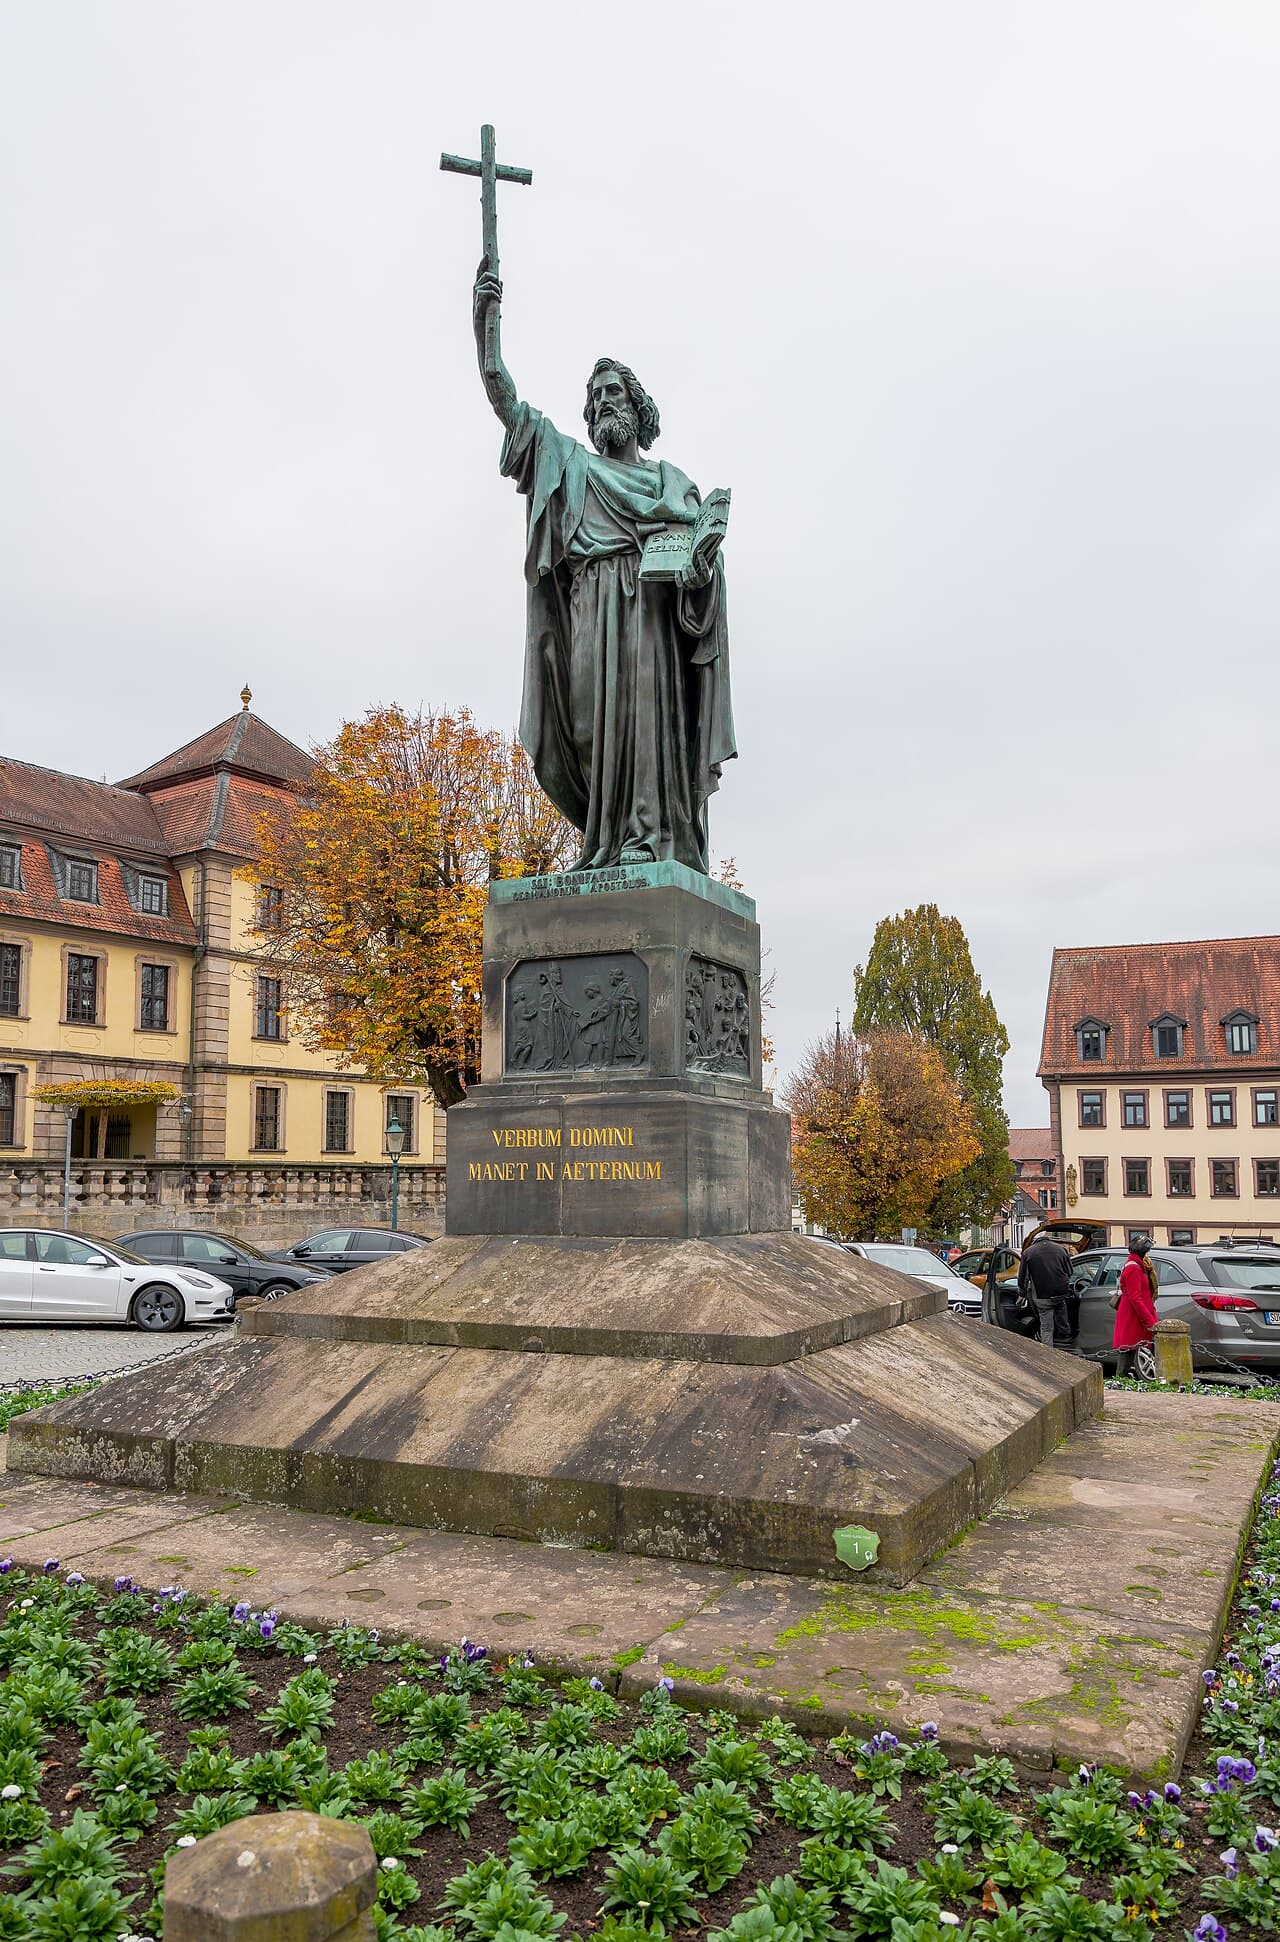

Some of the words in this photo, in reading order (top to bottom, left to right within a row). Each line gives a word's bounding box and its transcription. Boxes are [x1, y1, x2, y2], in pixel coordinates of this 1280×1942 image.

[492, 1128, 562, 1147] VERBUM
[569, 1127, 634, 1147] DOMINI
[468, 1161, 529, 1181] MANET
[535, 1162, 555, 1181] IN
[561, 1161, 662, 1181] AETERNUM
[852, 1541, 859, 1554] 1
